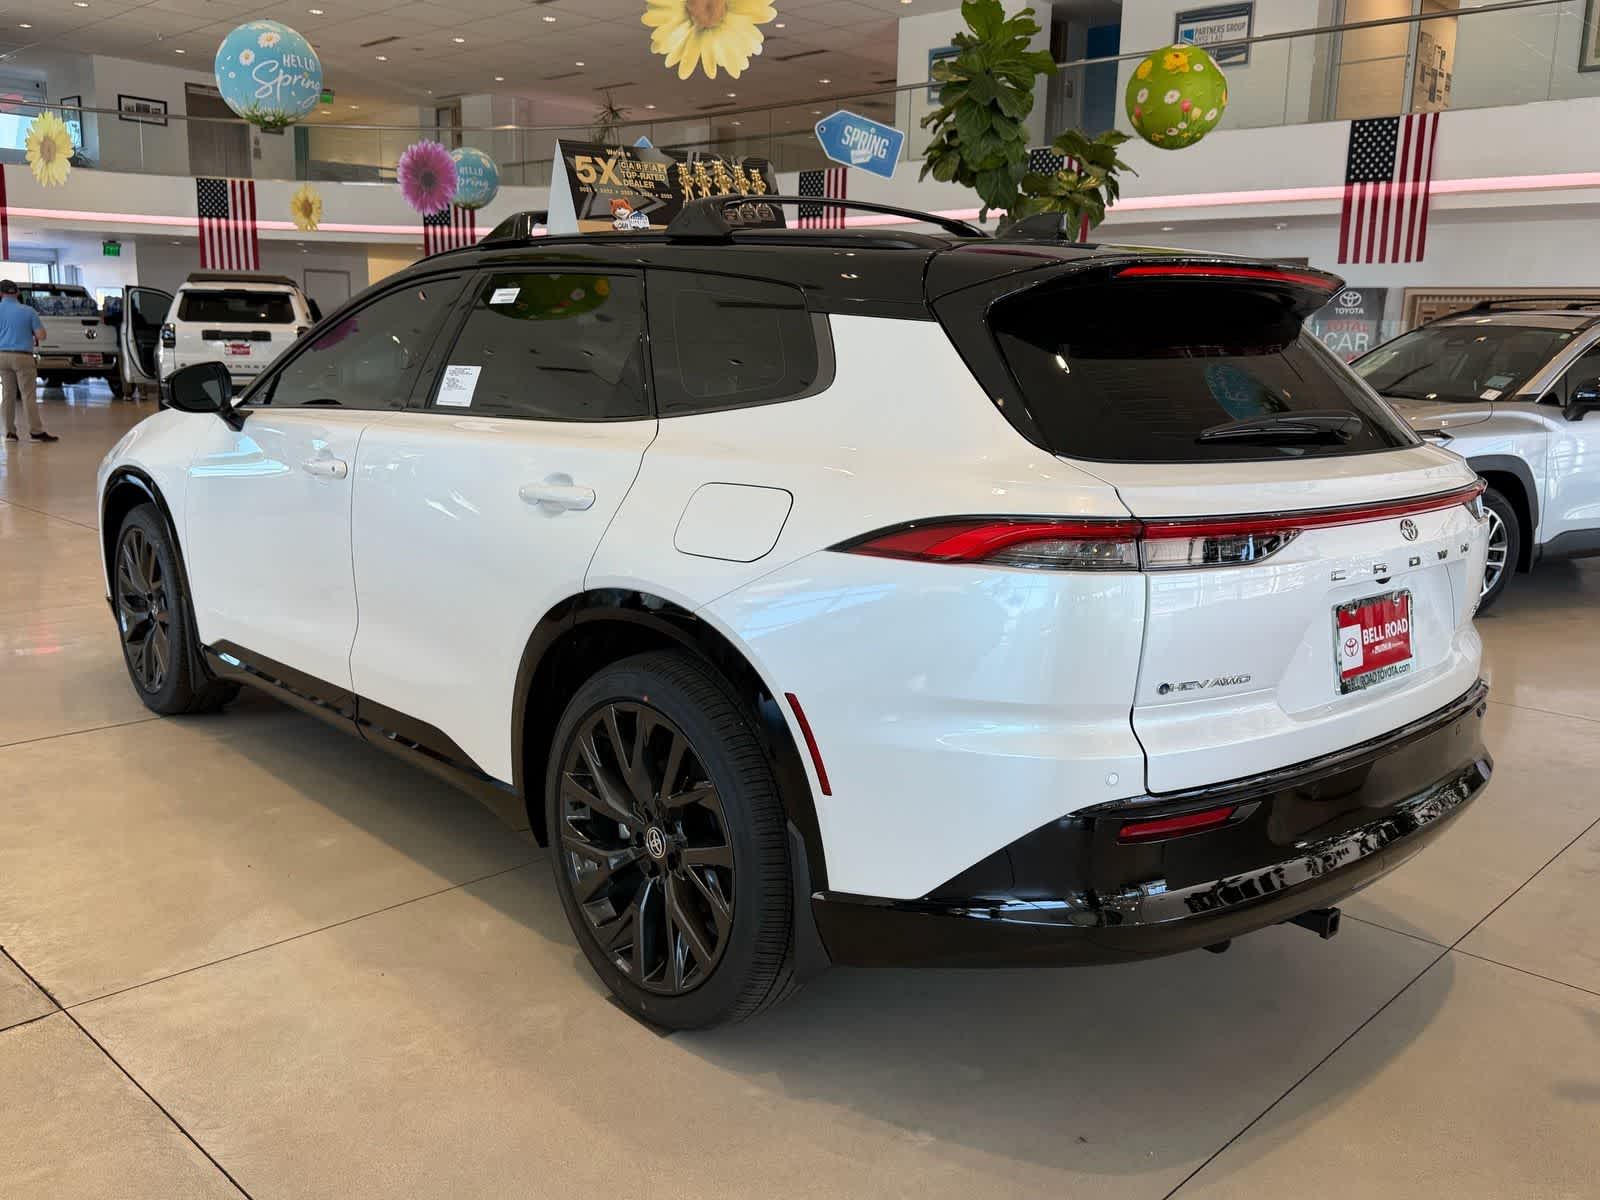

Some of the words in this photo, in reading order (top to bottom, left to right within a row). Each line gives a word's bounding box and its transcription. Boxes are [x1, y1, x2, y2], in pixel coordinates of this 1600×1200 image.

[282, 53, 316, 72] HELLO
[251, 59, 321, 108] Spring
[841, 125, 889, 159] SPRING
[575, 155, 623, 186] 5X
[621, 171, 667, 182] TOP-RATED
[623, 179, 656, 190] DEALER
[1335, 307, 1365, 315] TOYOTA
[1323, 331, 1370, 353] CAR
[1330, 543, 1471, 582] CROWN
[1362, 625, 1385, 646] BELL
[1384, 617, 1409, 639] ROAD
